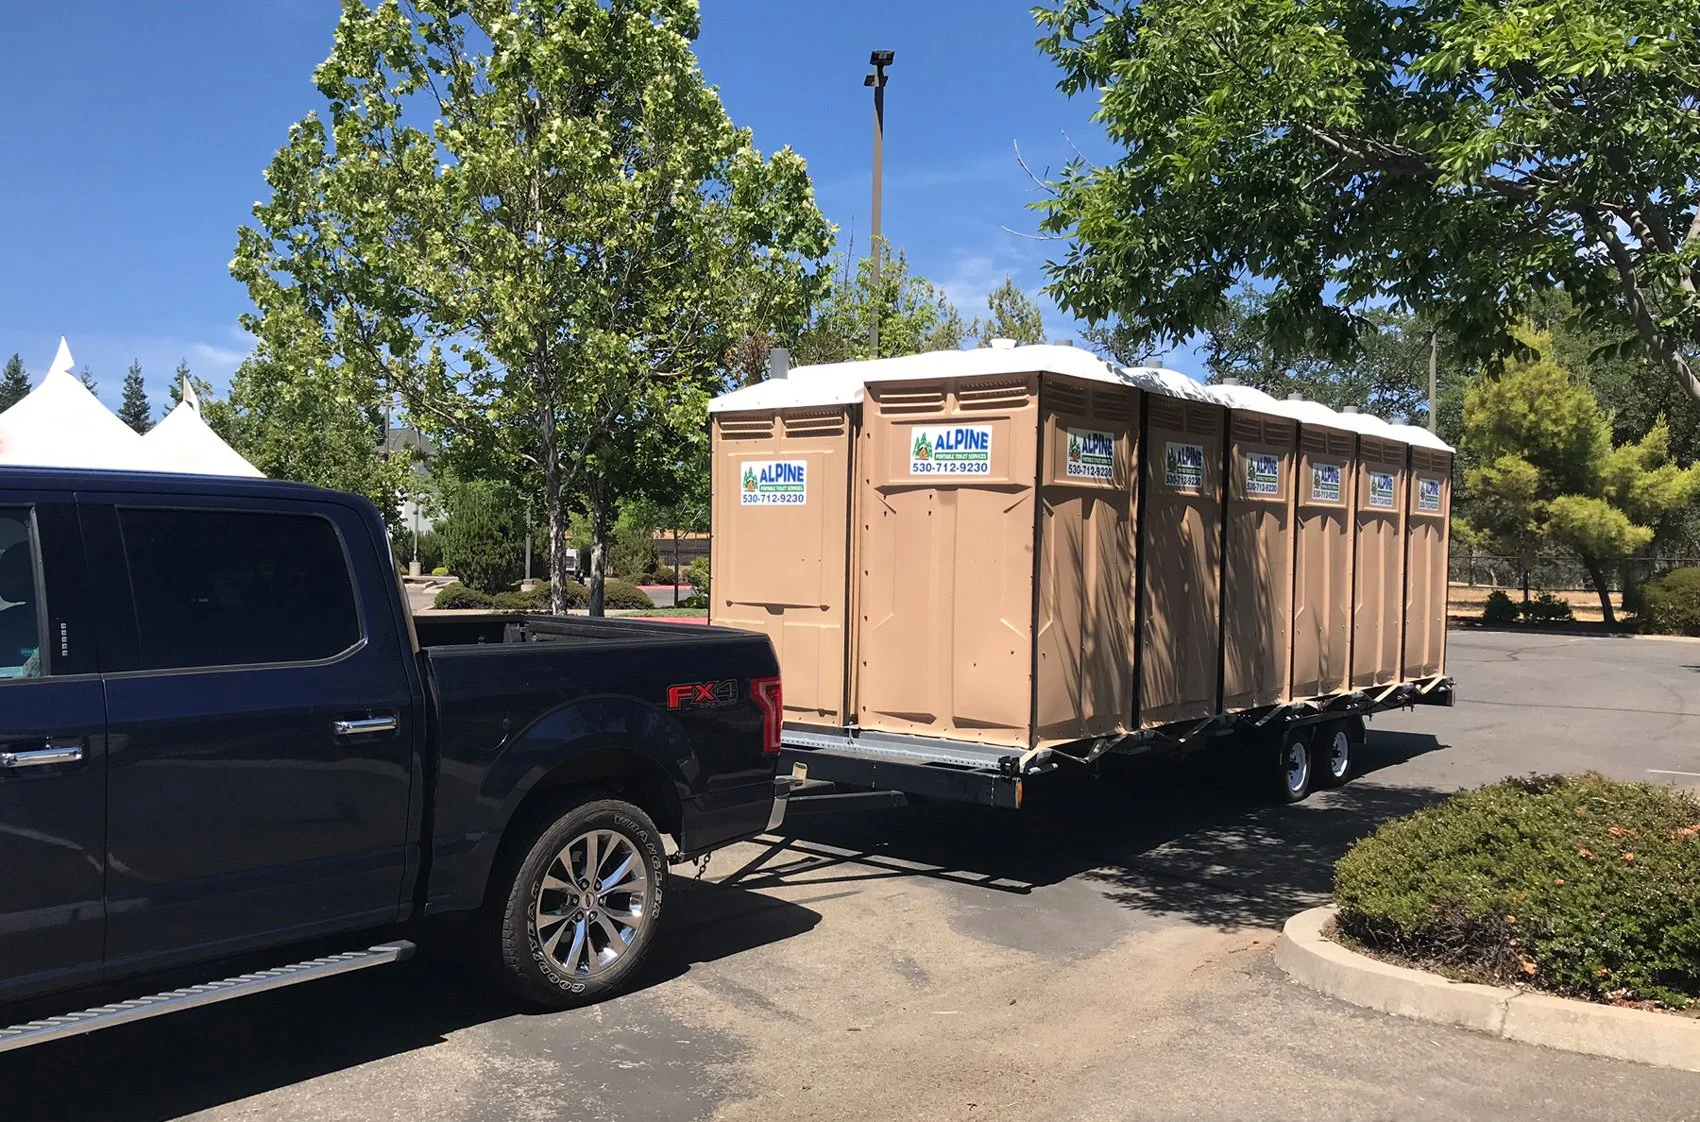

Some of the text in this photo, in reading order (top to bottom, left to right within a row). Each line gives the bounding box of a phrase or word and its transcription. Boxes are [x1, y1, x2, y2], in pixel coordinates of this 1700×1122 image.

[935, 429, 989, 450] ALPINE
[1082, 433, 1112, 456] ALPINE
[1177, 446, 1202, 467] ALPINE
[1256, 456, 1277, 475] ALPINE
[760, 463, 804, 483] ALPINE
[912, 462, 988, 473] 530-712-9230
[1068, 464, 1112, 477] 530-712-9230
[743, 494, 804, 503] 530-712-9230
[667, 679, 738, 711] FX4
[614, 815, 663, 919] WRANGLER
[527, 882, 586, 993] GOODYEAR
